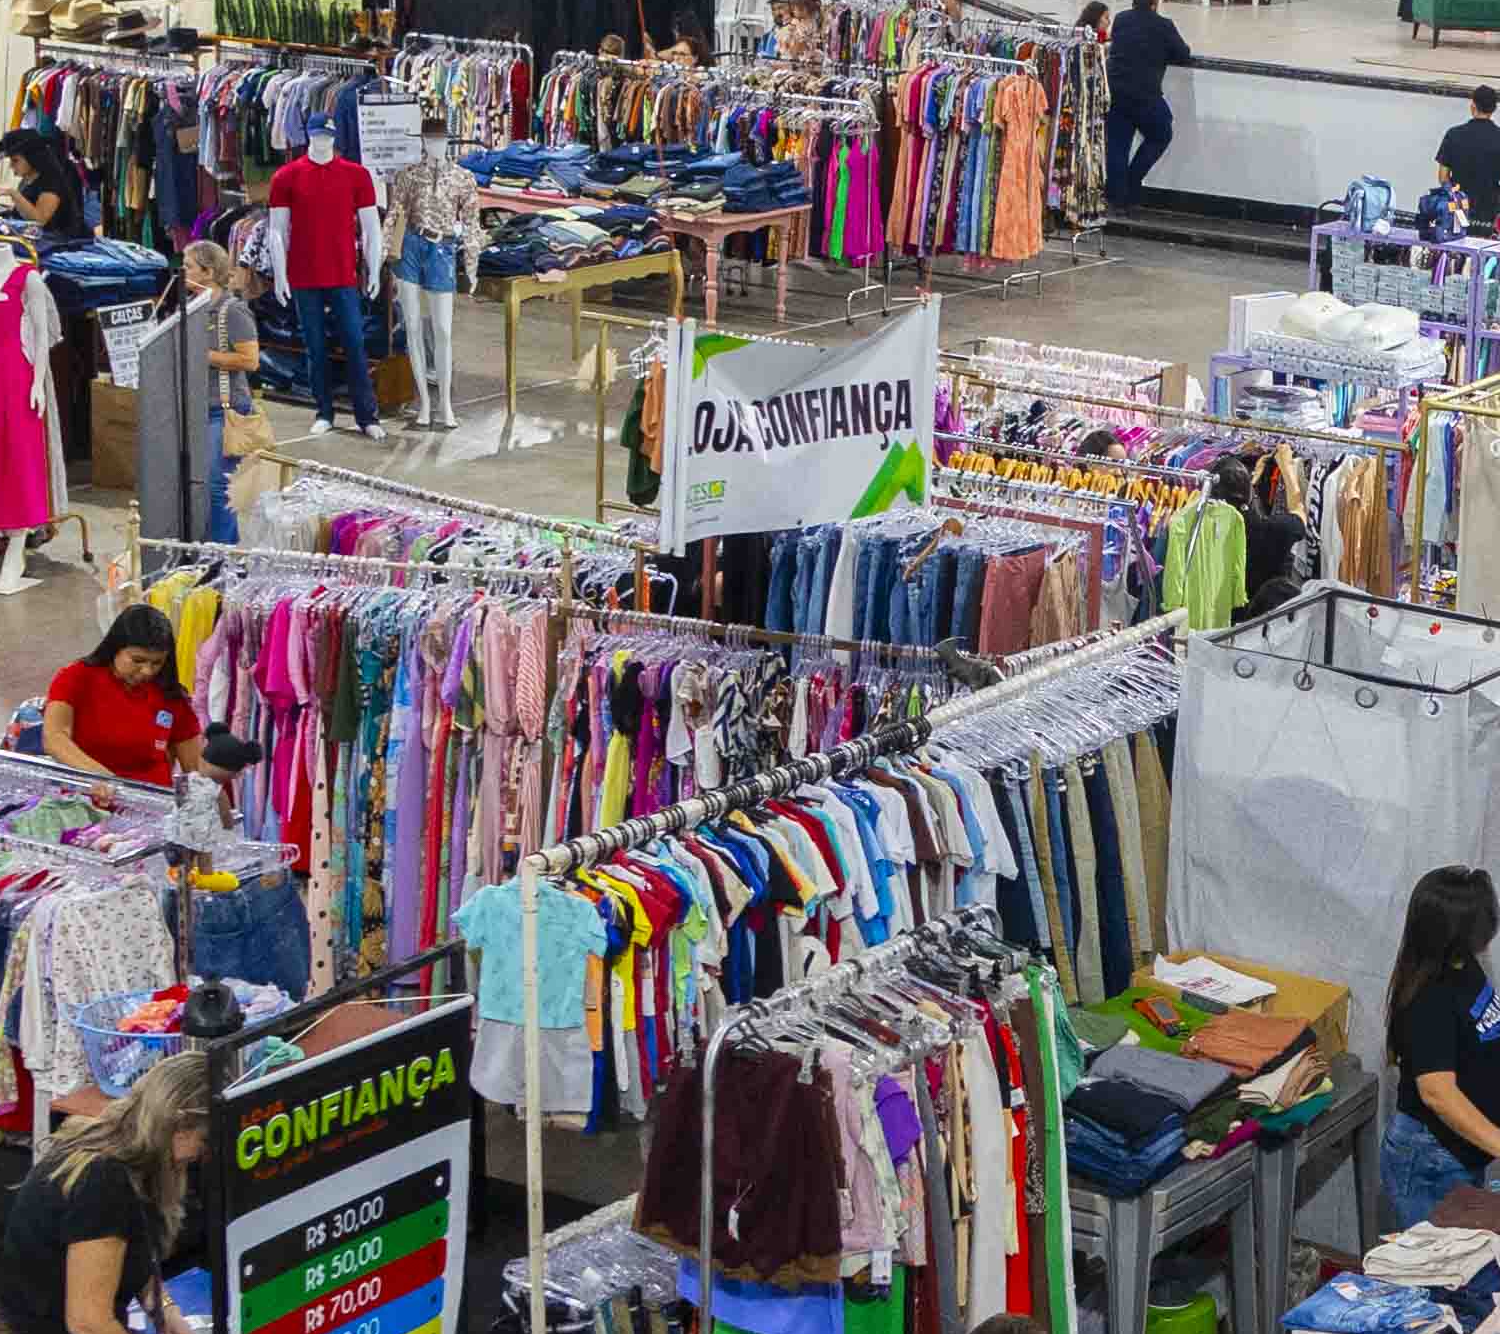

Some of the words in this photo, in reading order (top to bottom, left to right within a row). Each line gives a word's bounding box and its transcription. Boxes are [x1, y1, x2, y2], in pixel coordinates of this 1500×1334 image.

[689, 399, 754, 456] OJA
[751, 378, 912, 451] CONFIANÇA
[235, 1047, 457, 1170] CONFIANÇA
[305, 1221, 327, 1252] R$
[331, 1195, 385, 1239] 30,00
[304, 1263, 326, 1292] R$
[330, 1235, 384, 1280] 50,00
[304, 1304, 326, 1334] R$
[329, 1275, 383, 1322] 70,00
